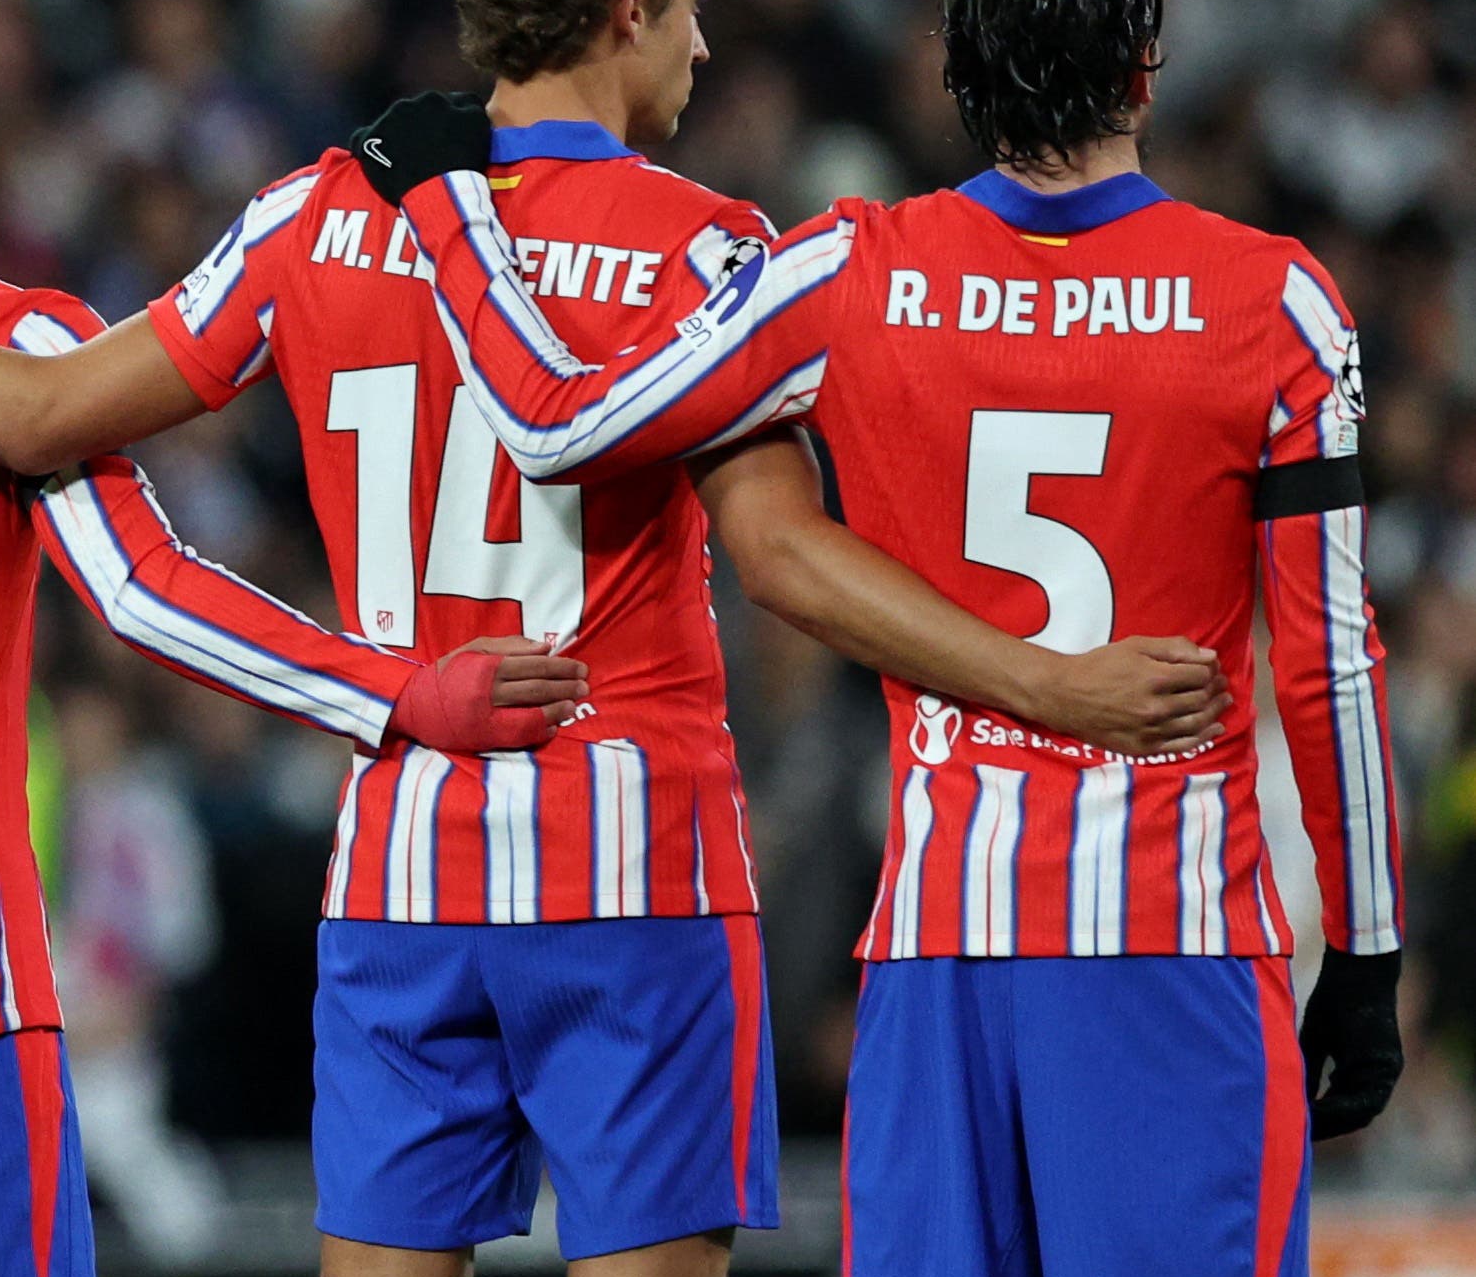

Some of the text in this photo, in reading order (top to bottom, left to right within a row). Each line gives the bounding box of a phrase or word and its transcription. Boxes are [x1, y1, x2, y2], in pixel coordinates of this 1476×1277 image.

[309, 208, 373, 270] M.
[885, 269, 1206, 338] R. DE PAUL
[325, 362, 587, 657] 14
[963, 408, 1116, 656] 5
